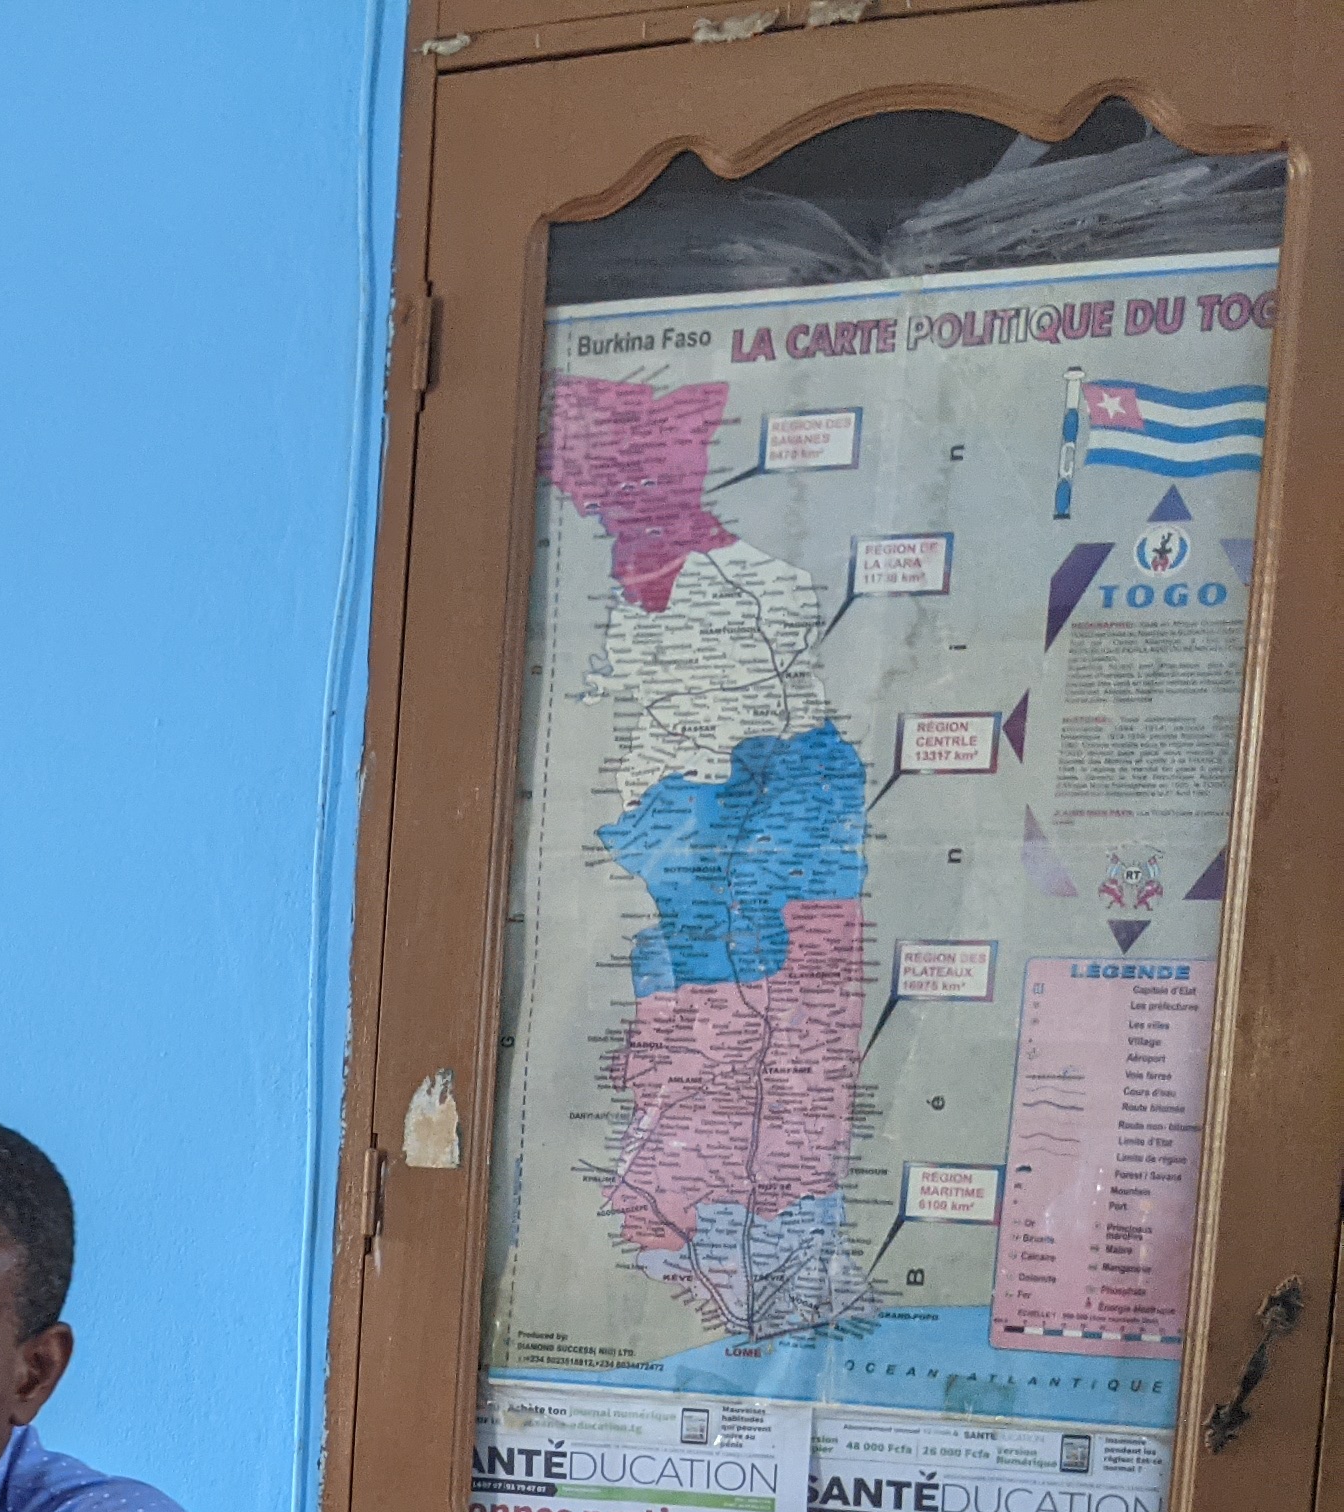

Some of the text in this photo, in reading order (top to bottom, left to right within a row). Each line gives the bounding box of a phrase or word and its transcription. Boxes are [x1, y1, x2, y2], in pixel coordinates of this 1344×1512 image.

[731, 326, 777, 364] LA
[786, 317, 898, 360] CARTE
[907, 299, 1115, 351] POLITIQUE
[1124, 295, 1186, 337] DU
[577, 328, 712, 357] Burkina Faso
[1099, 581, 1228, 610] TOGO
[1126, 870, 1141, 880] RT
[903, 965, 973, 978] PLATEAUX
[1071, 962, 1191, 981] LÉGENDE
[1130, 1001, 1147, 1010] Les
[1128, 1020, 1145, 1030] Les
[1127, 1037, 1162, 1048] Village
[1123, 1086, 1151, 1097] Cours
[920, 1184, 985, 1199] MARITIME
[517, 1330, 555, 1340] Produced
[517, 1343, 555, 1352] DIAMOND
[966, 1371, 1164, 1395] ATLANTIQUE
[548, 1406, 568, 1416] ton
[568, 1406, 612, 1418] journal
[612, 1406, 677, 1422] numérique
[721, 1415, 765, 1424] habitudes
[846, 1441, 861, 1450] 48
[863, 1442, 885, 1453] 000
[887, 1443, 913, 1455] Fcfa
[940, 1447, 962, 1457] 000
[965, 1448, 990, 1459] Fcfa
[996, 1456, 1058, 1469] Numérique
